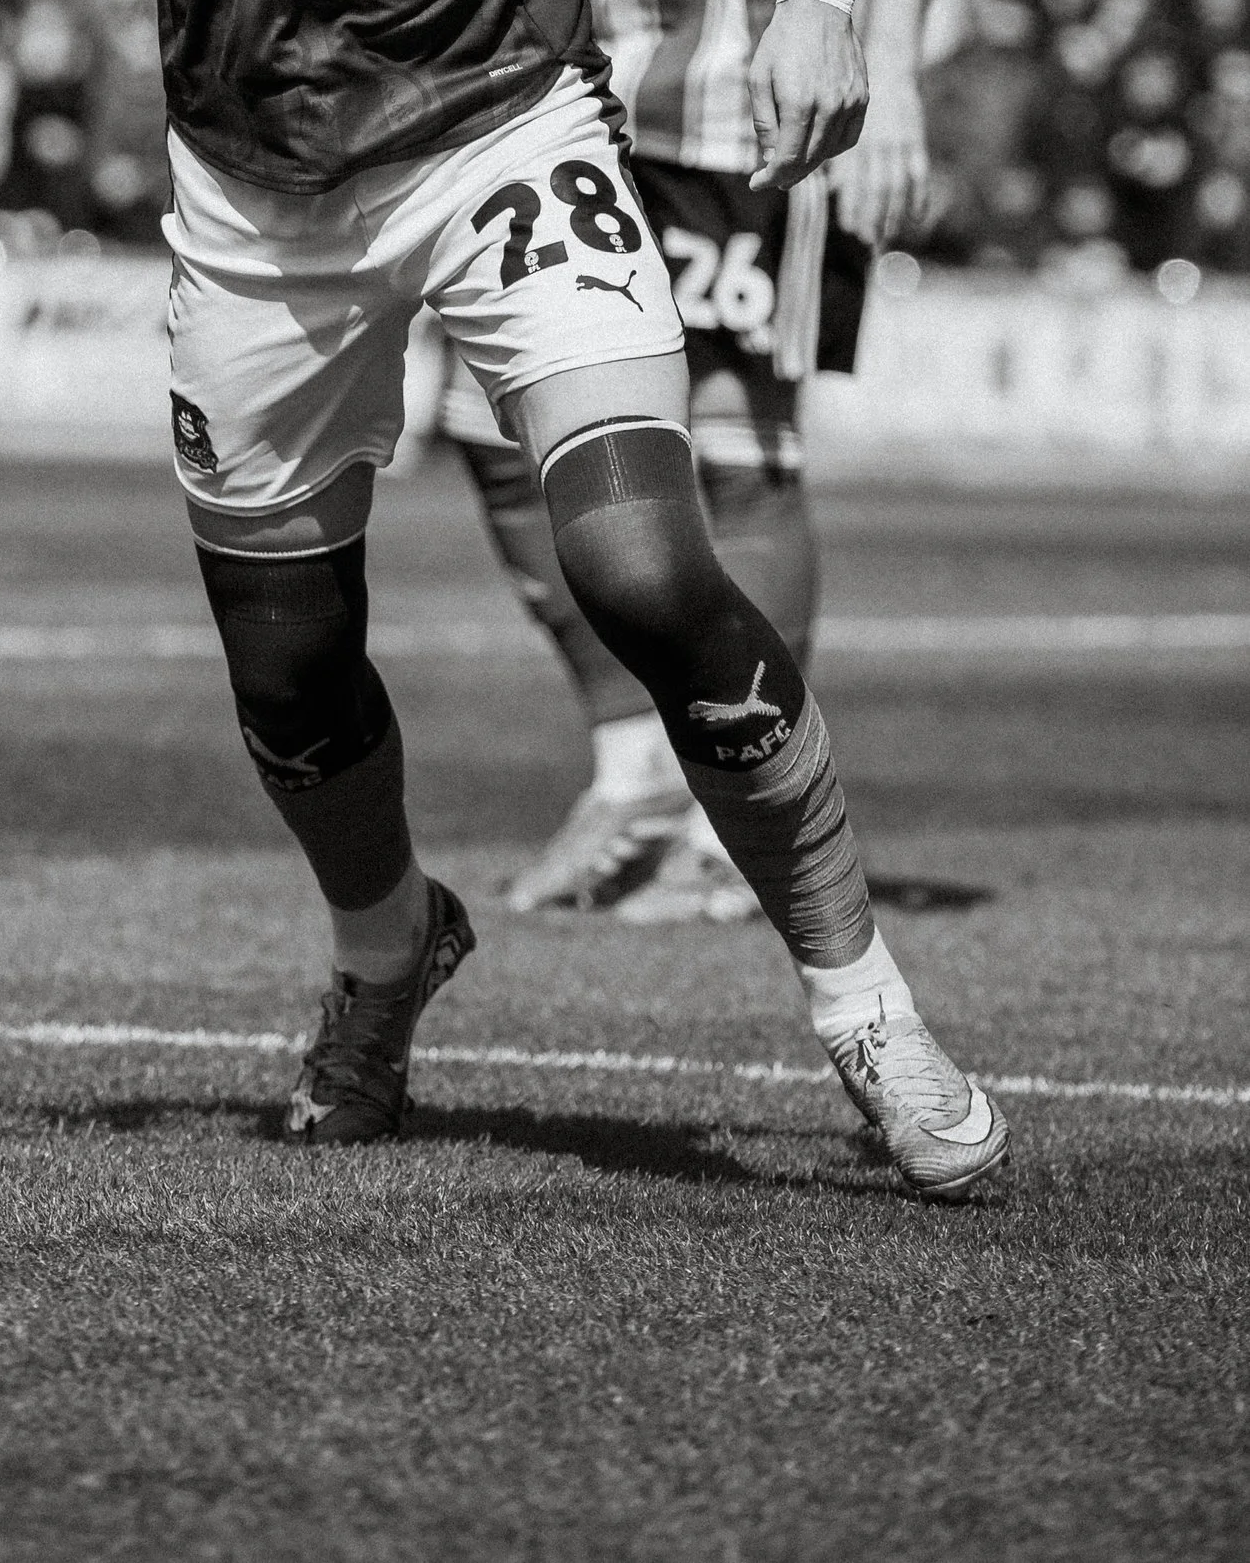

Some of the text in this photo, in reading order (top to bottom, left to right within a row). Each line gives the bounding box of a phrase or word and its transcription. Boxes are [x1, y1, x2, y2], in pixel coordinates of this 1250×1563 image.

[489, 63, 524, 78] DRYCELL
[470, 159, 642, 290] 28
[527, 263, 541, 274] EFL
[661, 225, 776, 333] 26
[715, 718, 792, 762] PAFC
